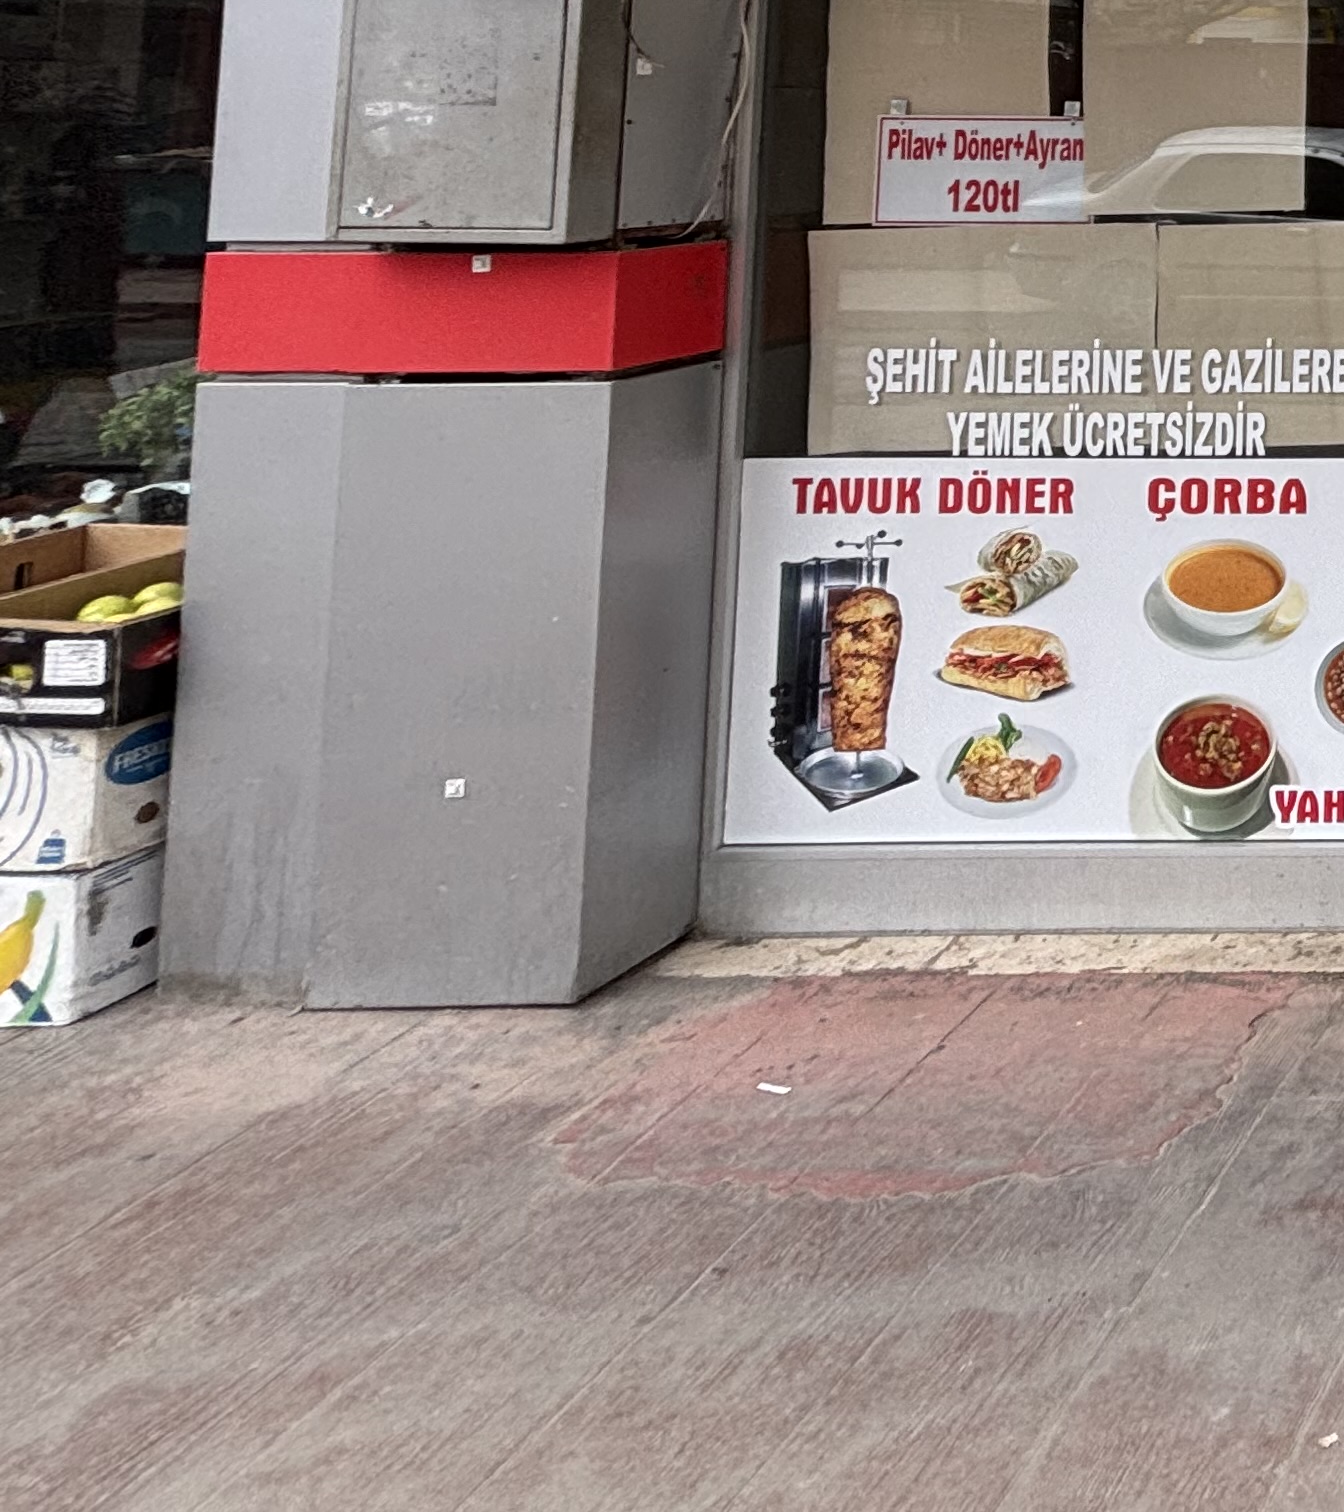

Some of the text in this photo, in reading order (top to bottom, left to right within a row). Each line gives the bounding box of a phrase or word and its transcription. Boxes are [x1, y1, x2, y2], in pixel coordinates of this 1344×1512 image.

[887, 128, 948, 163] Pilav+
[947, 178, 1020, 214] 120tl
[866, 337, 957, 404] ŞEHİT
[964, 337, 1143, 394] AİLELERİNE
[1152, 348, 1193, 394] VE
[946, 400, 1266, 457] YEMEK ÜCRETSİZDİR
[792, 477, 922, 515] TAVUK
[937, 470, 1075, 515] DÖNER
[1147, 476, 1309, 523] ÇORBA
